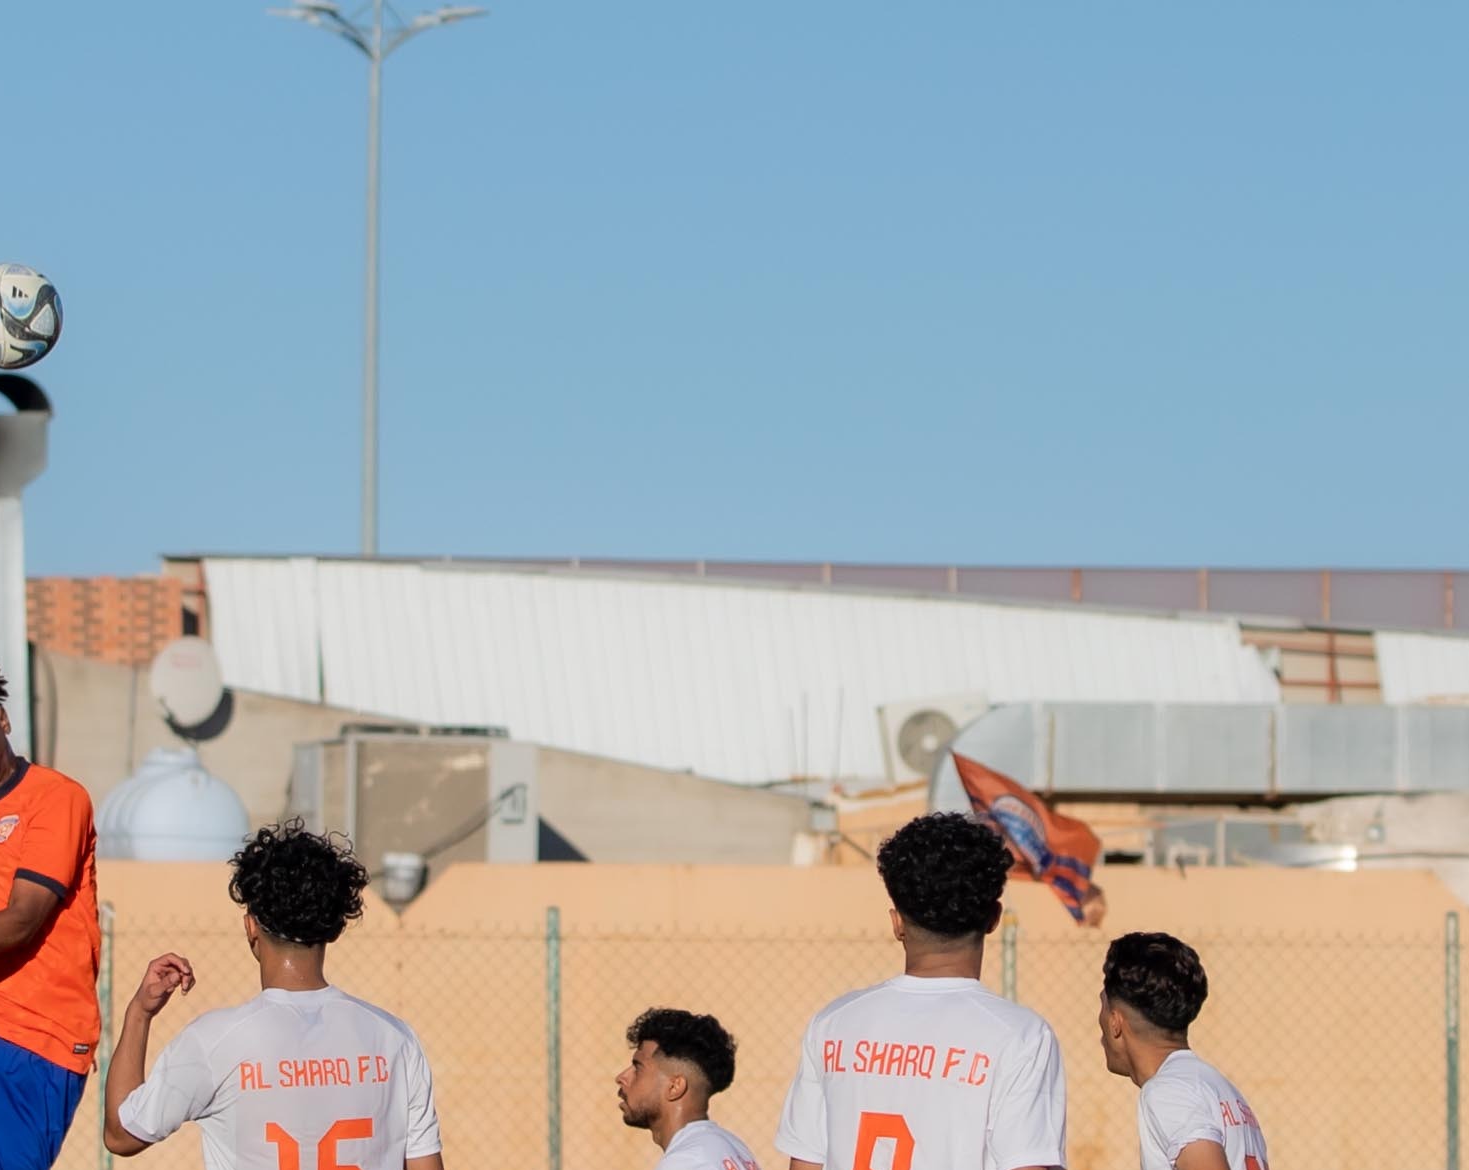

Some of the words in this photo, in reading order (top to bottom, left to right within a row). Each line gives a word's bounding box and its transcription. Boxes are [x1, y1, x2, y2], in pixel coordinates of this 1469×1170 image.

[239, 1061, 273, 1091] AL
[278, 1057, 352, 1088] SHARQ
[823, 1039, 846, 1073] AL
[852, 1040, 936, 1080] SHARQ
